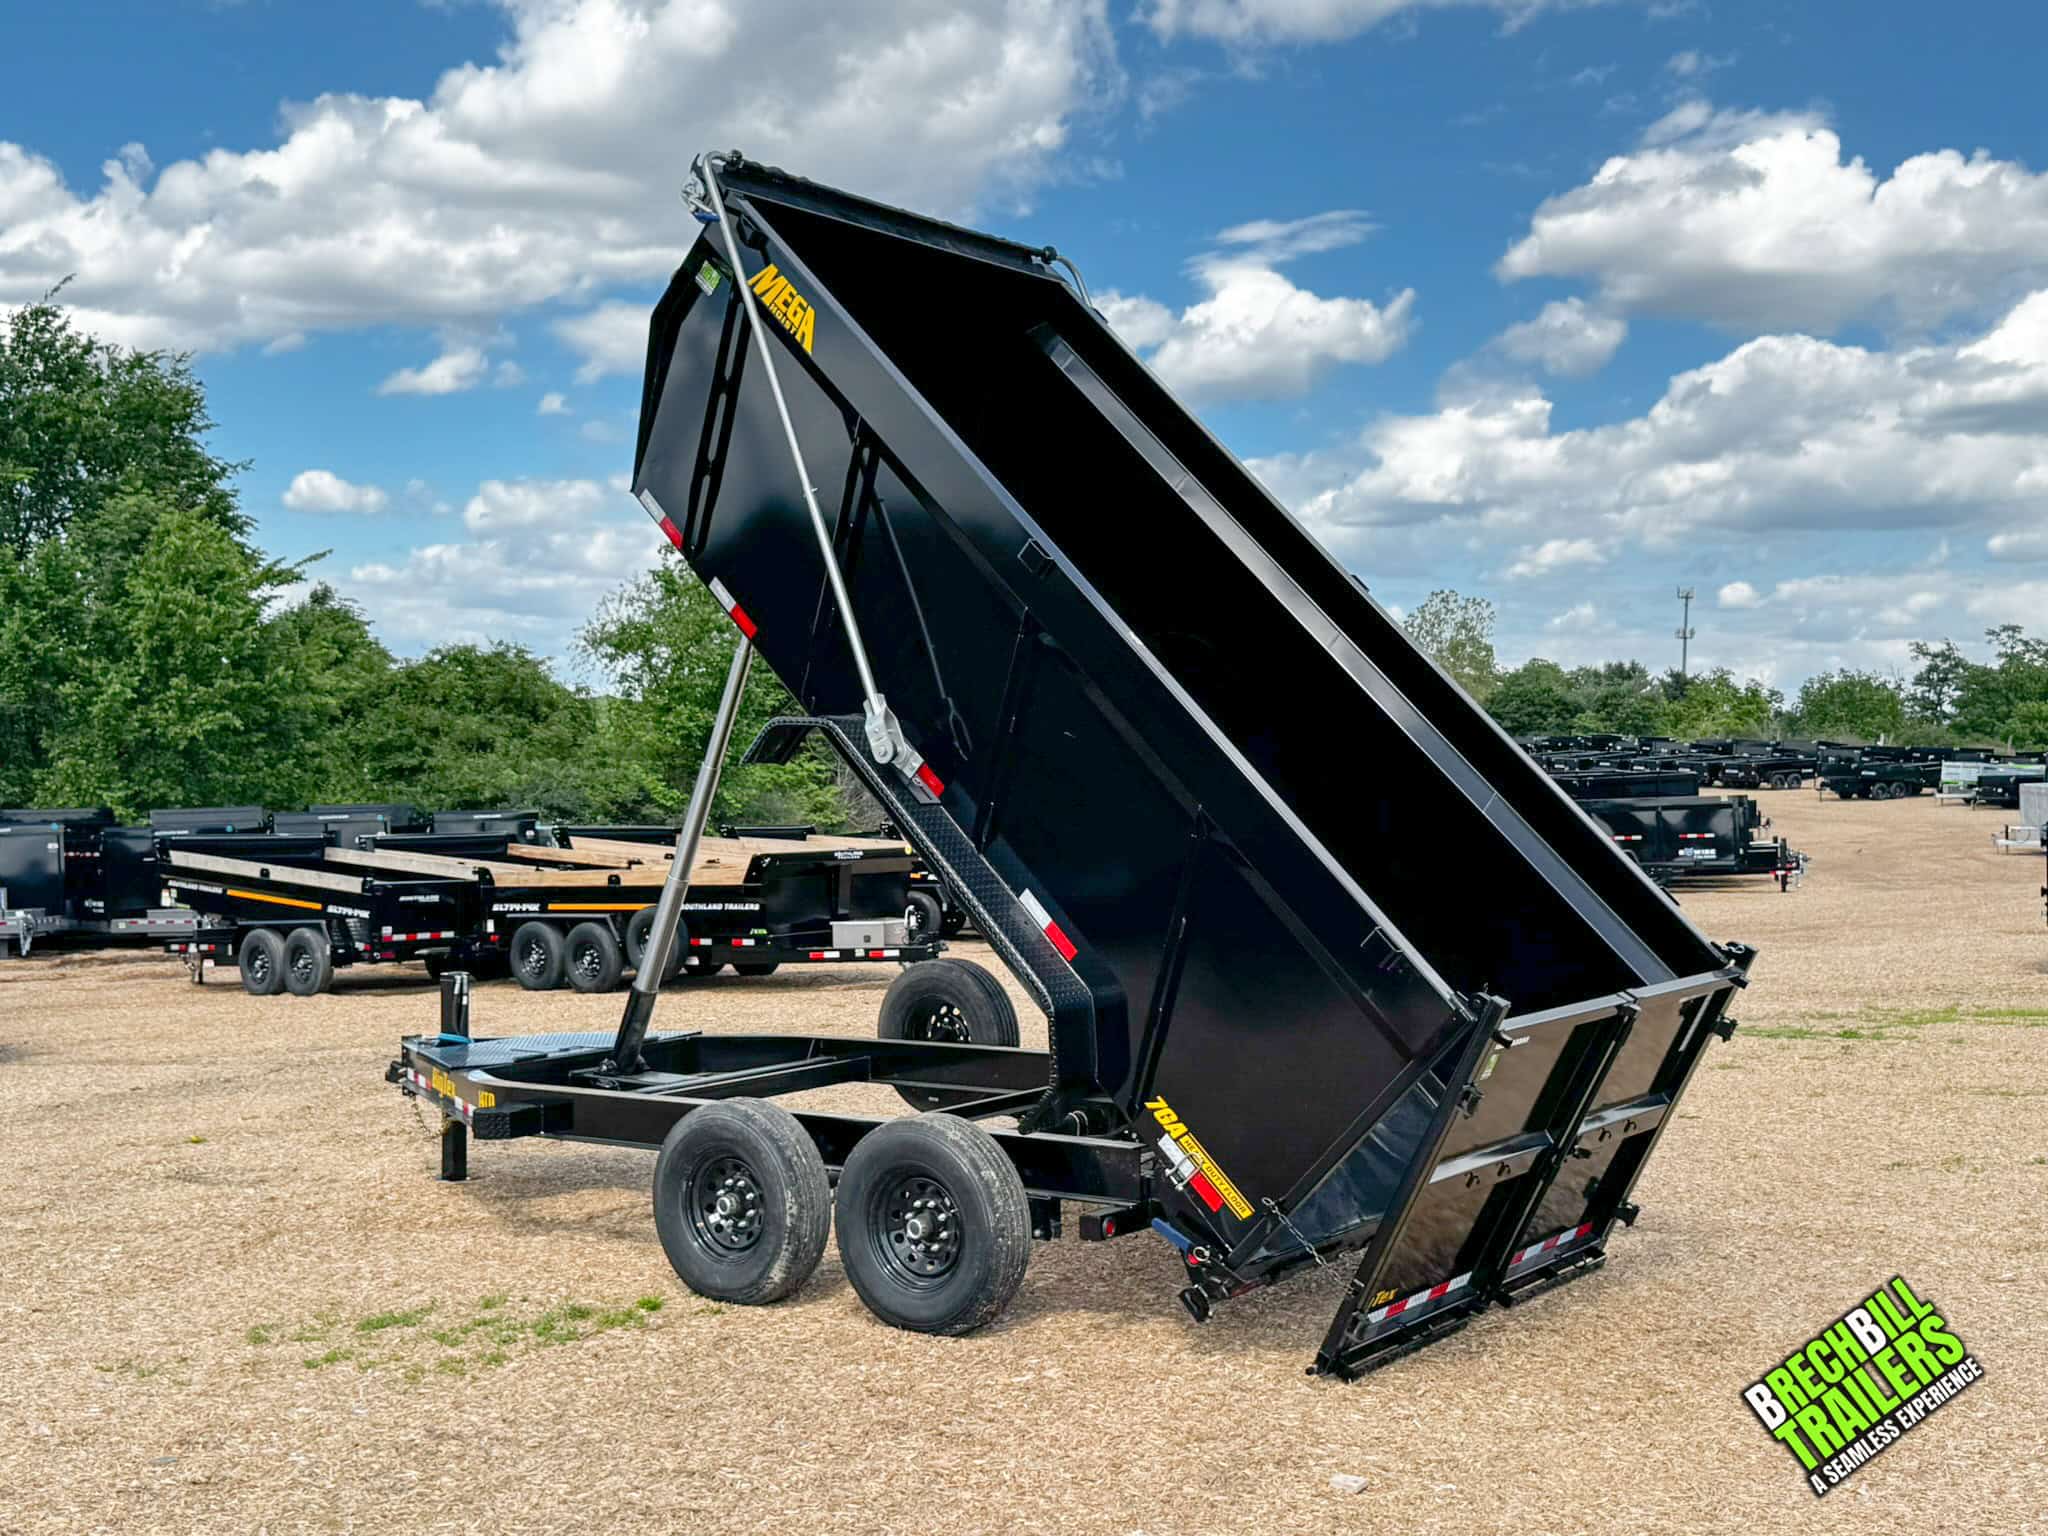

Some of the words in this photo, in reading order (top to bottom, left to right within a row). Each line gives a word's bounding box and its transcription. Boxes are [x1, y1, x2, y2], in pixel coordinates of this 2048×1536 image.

[747, 263, 815, 356] MEGA
[769, 303, 798, 335] HOIST
[1222, 1186, 1248, 1214] FLOOR
